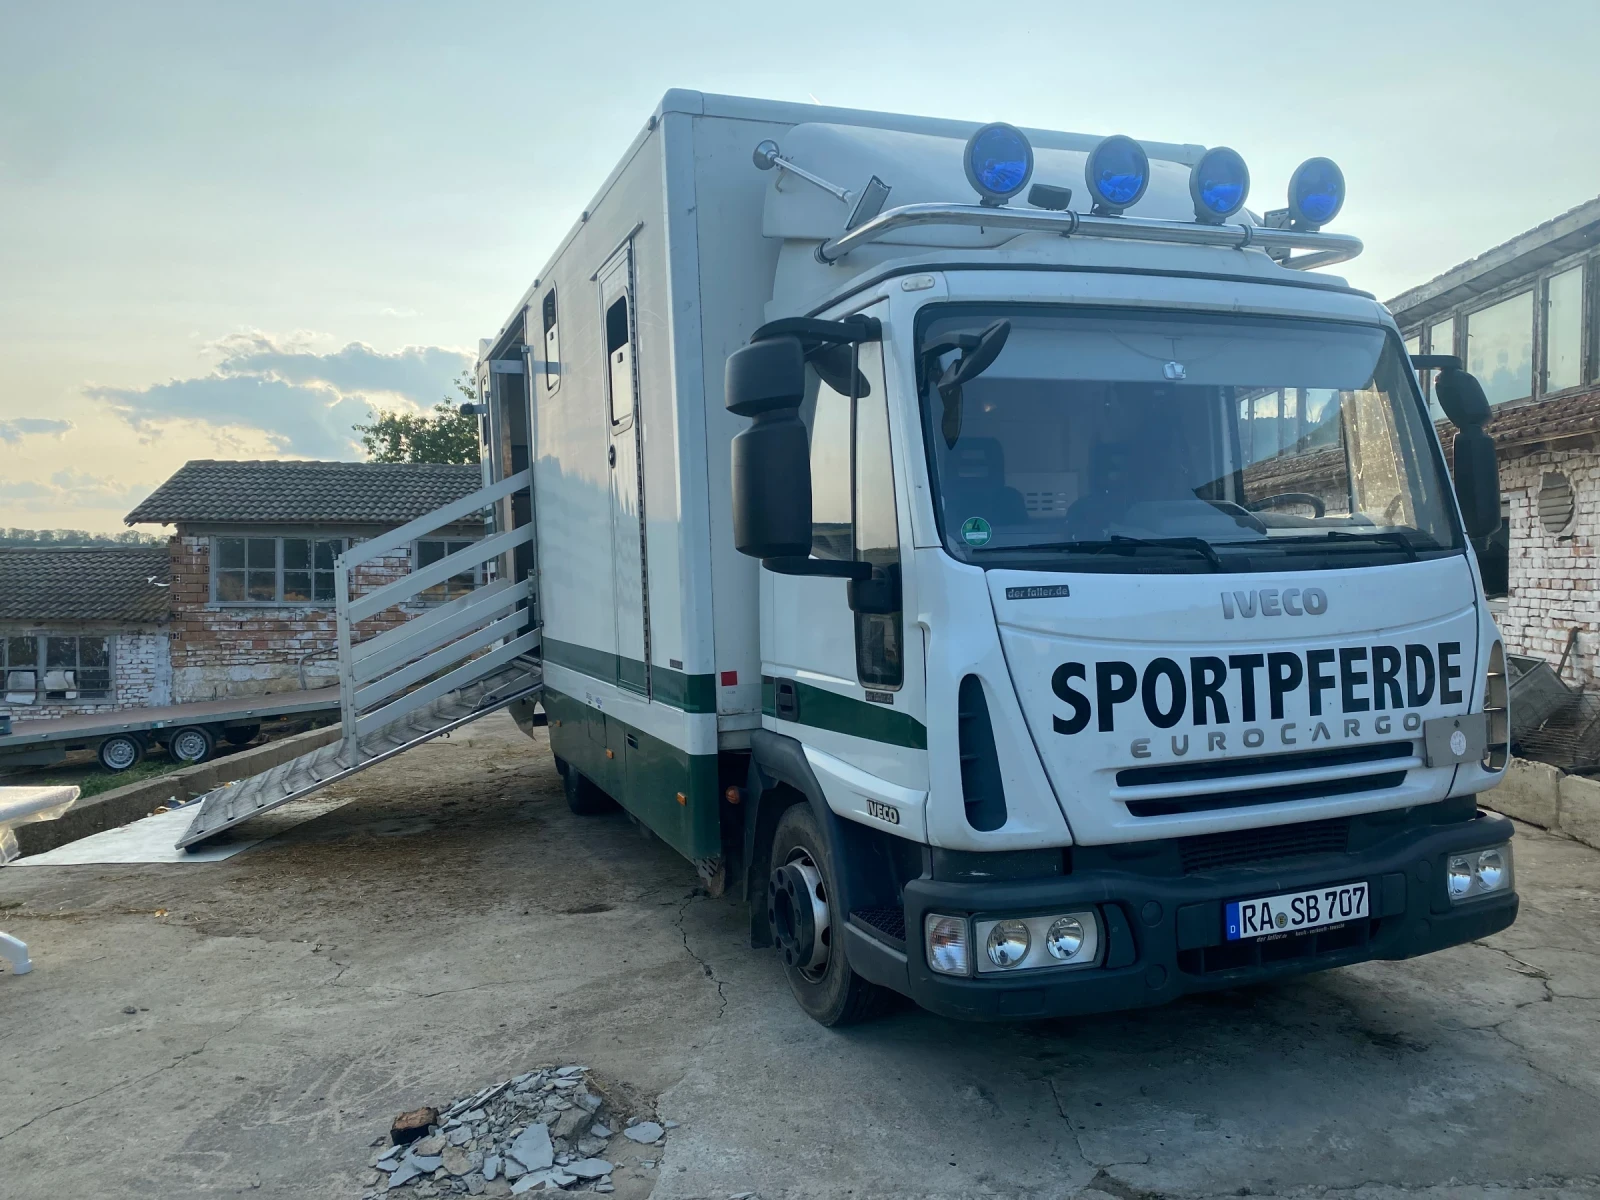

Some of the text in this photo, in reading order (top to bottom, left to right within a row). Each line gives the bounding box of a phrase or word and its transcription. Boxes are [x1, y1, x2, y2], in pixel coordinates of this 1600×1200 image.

[1007, 586, 1068, 599] der faller.de
[1220, 587, 1328, 620] IVECO
[1051, 641, 1463, 735] SPORTPFERDE
[1130, 712, 1422, 759] EUROCARGO
[866, 799, 900, 825] IVECO
[1242, 886, 1366, 934] RA SB 707
[1230, 925, 1236, 934] D
